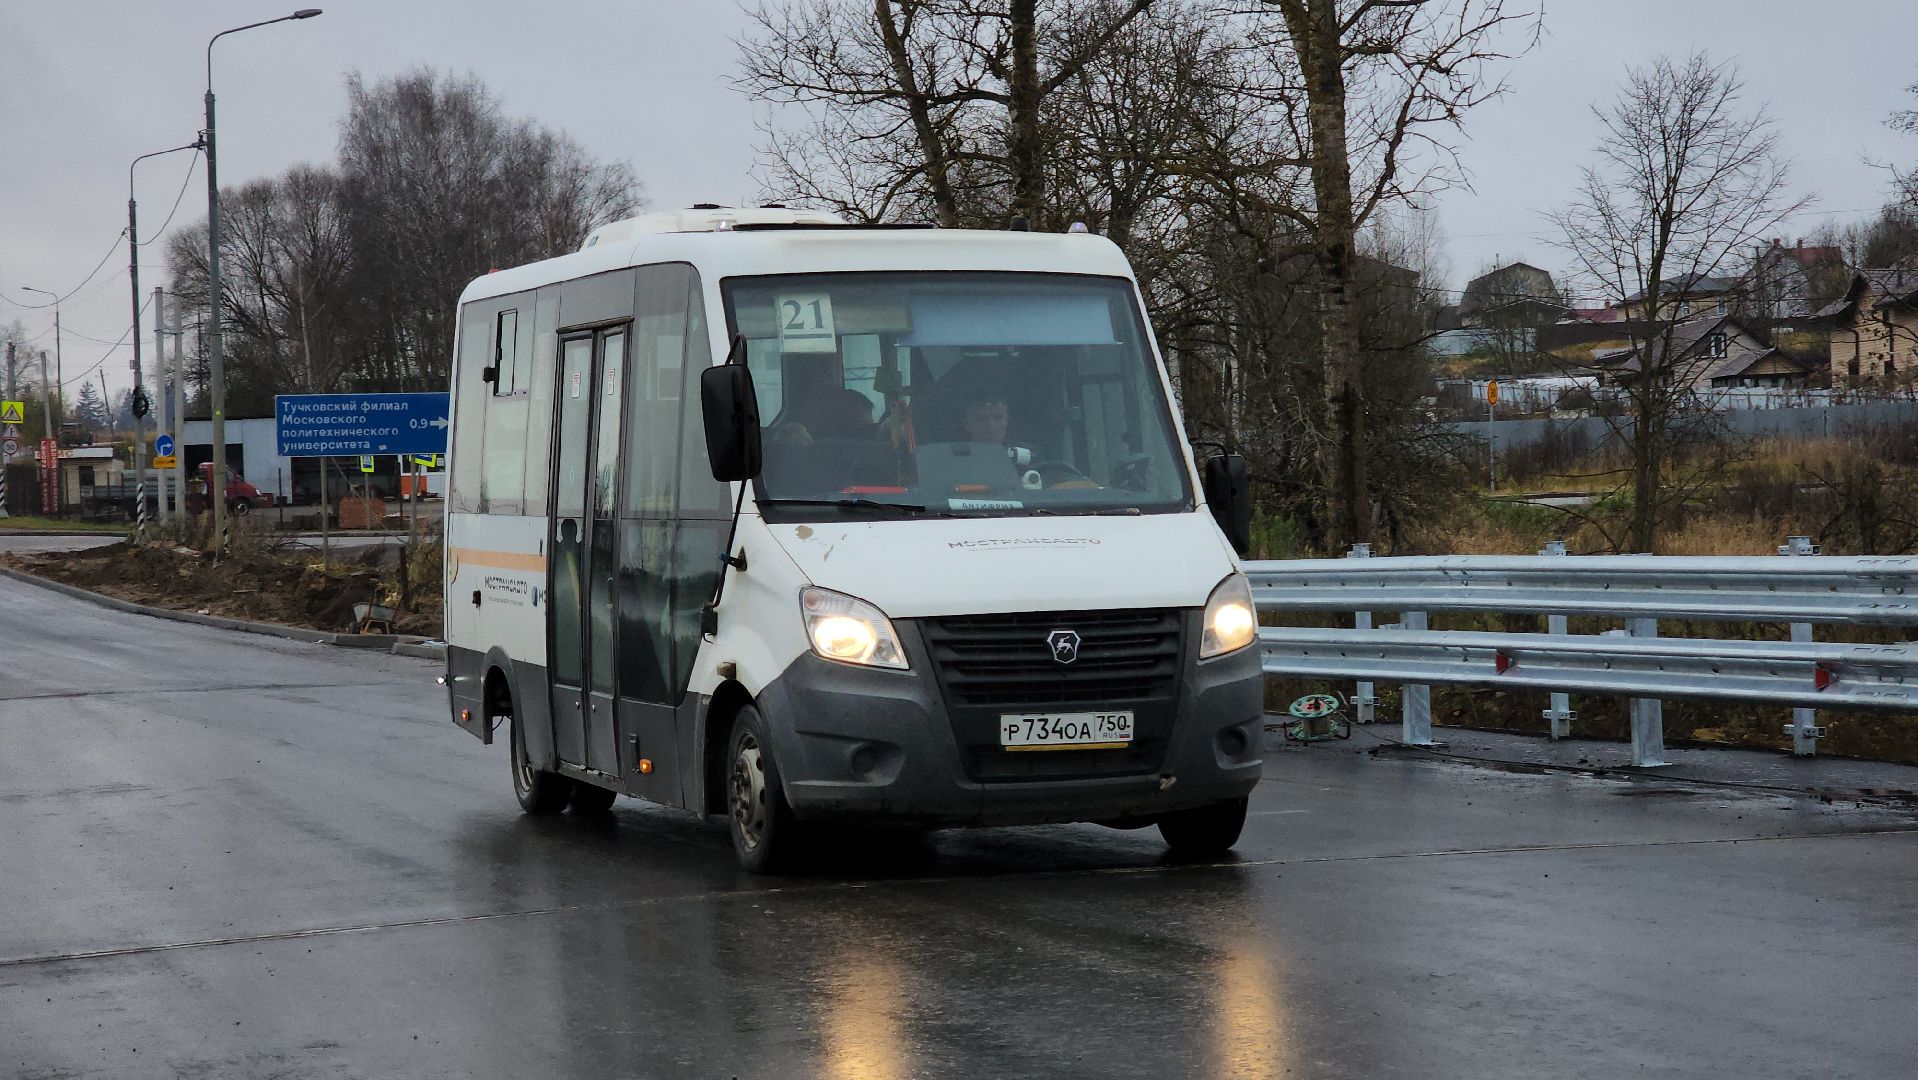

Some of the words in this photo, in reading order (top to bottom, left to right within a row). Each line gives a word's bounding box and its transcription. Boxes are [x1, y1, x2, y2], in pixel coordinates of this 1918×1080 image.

[783, 299, 824, 330] 21
[282, 401, 357, 414] Тучковский
[361, 401, 409, 413] филиал
[282, 415, 367, 425] Московского
[282, 427, 399, 438] политехнического
[6, 443, 15, 451] 50
[283, 440, 371, 452] университета
[1096, 715, 1128, 732] 750
